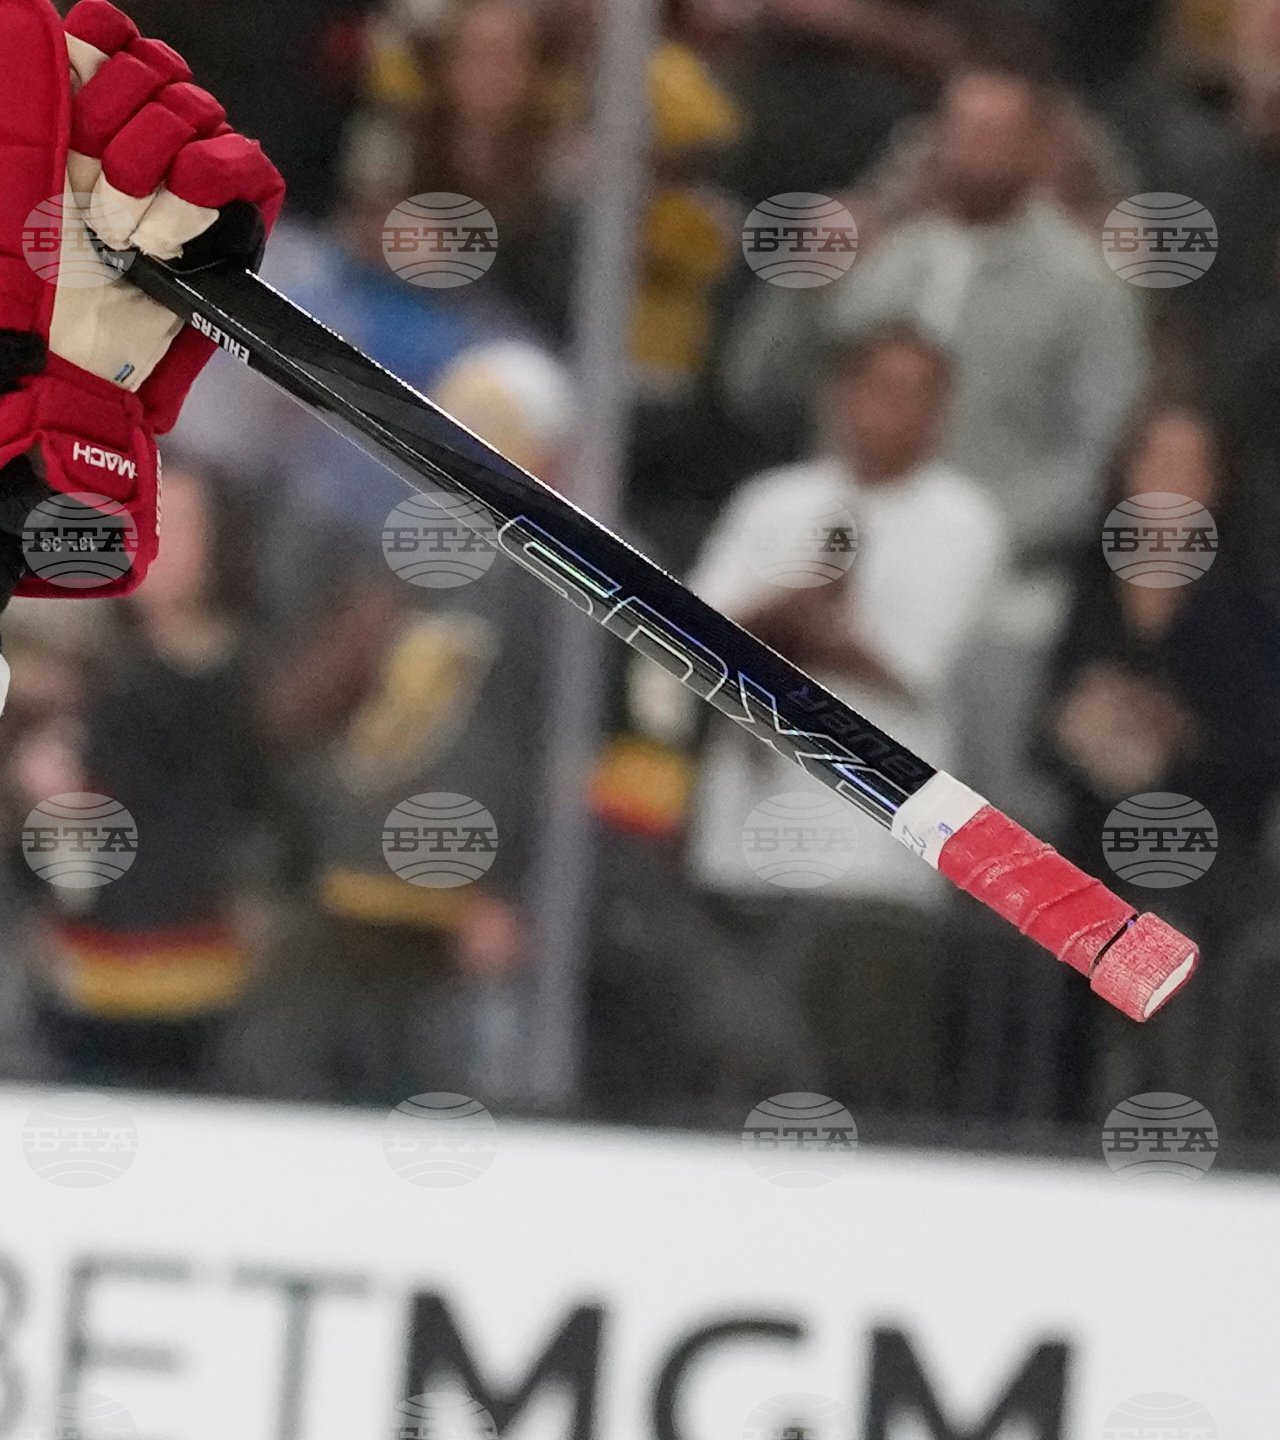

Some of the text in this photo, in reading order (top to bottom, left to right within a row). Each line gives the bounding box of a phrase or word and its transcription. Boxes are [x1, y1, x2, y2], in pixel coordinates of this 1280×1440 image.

[190, 310, 251, 365] EHLERS
[73, 441, 137, 480] MACH
[497, 515, 908, 830] EXUS
[787, 682, 933, 788] AUER
